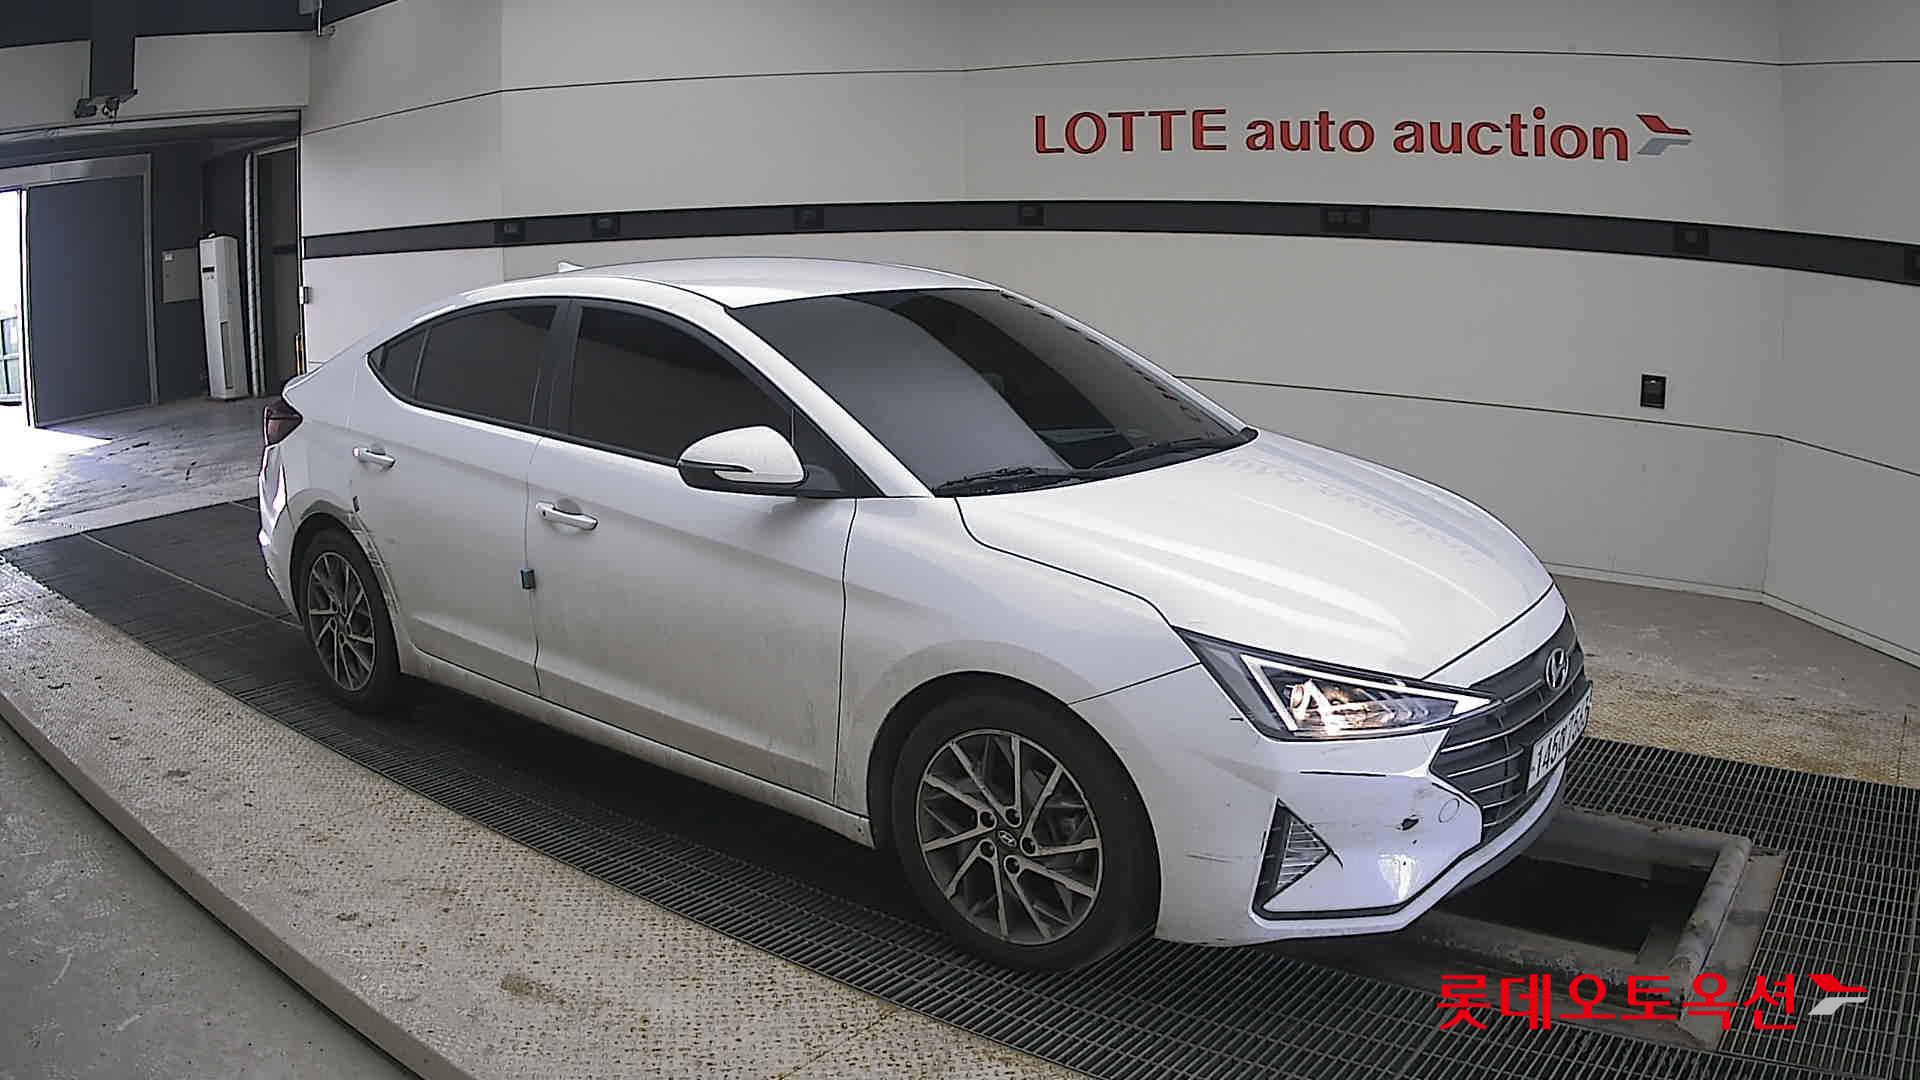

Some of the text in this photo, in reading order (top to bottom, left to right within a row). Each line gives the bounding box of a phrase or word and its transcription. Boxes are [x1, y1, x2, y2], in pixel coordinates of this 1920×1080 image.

[1035, 106, 1629, 161] LOTTE auto auction
